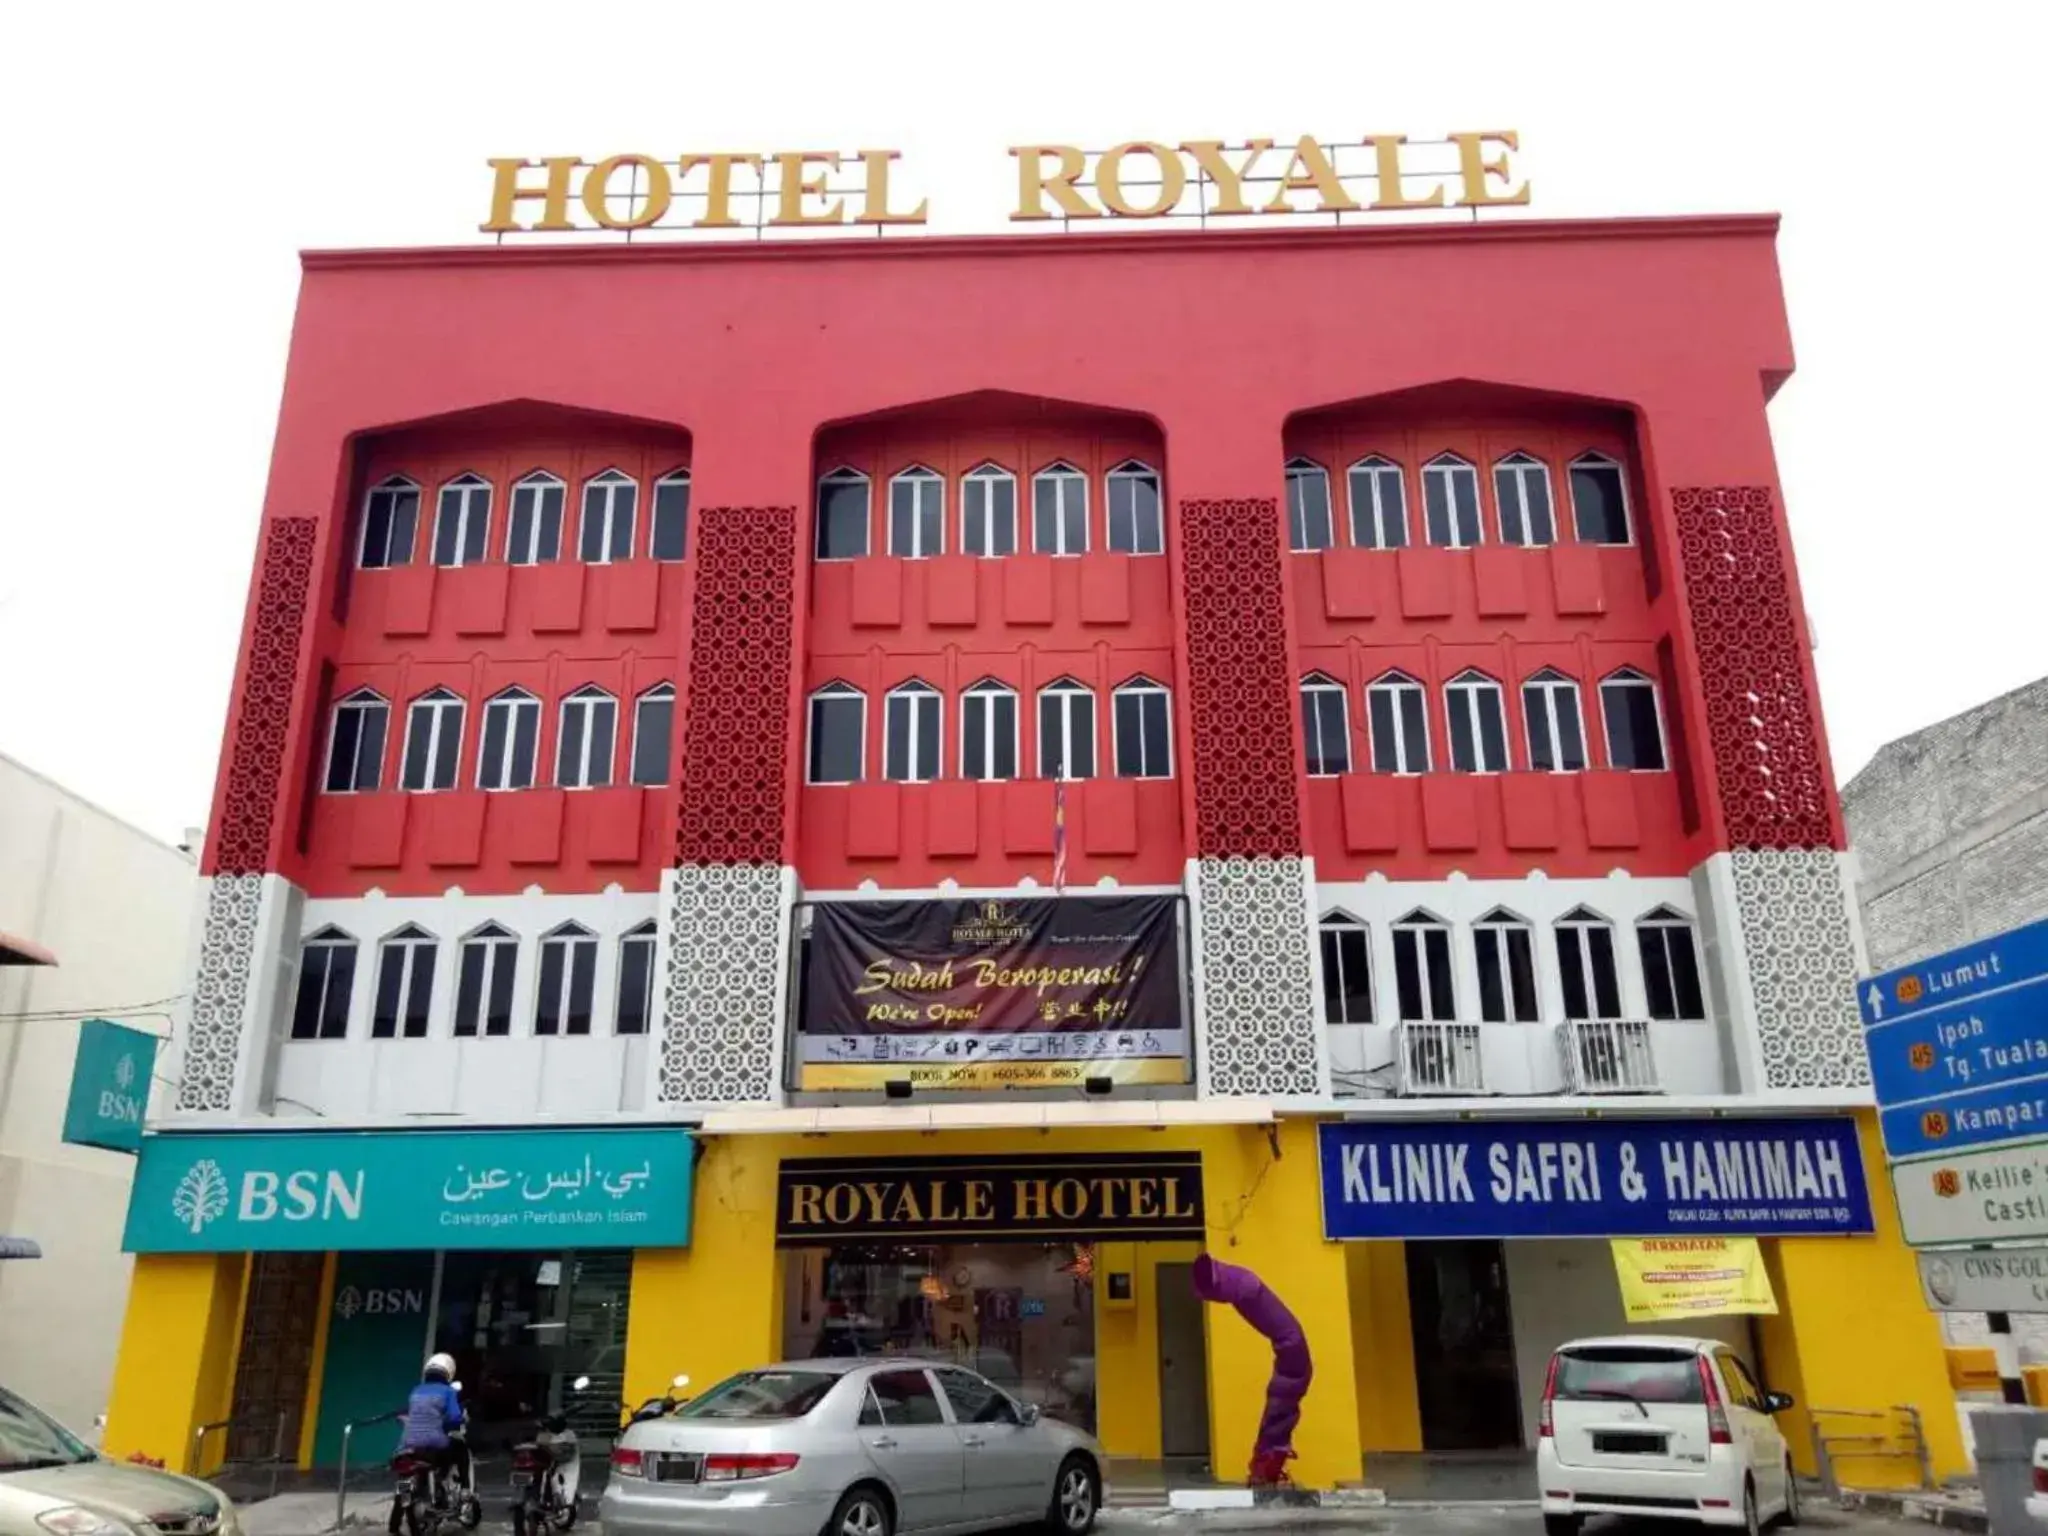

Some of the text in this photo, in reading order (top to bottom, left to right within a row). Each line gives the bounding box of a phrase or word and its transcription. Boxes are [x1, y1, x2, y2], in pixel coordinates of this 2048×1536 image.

[479, 129, 1531, 232] HOTEL ROYALE
[853, 957, 953, 994] Sudah
[1926, 951, 2001, 993] Lumut
[926, 1003, 984, 1026] Open!
[1937, 1015, 1984, 1049] Ipoh
[950, 1069, 978, 1081] NOW
[1944, 1056, 1978, 1082] Tg.
[97, 1089, 143, 1124] BSN
[1953, 1099, 2045, 1130] Kampar
[1341, 1139, 1848, 1203] KLINIK SAFRI & HAMIMAH
[237, 1169, 367, 1222] BSN
[788, 1176, 1195, 1225] ROYALE HOTEL
[439, 1209, 648, 1228] Cawangan Perbankan Islam
[1963, 1255, 2004, 1279] CWS
[364, 1287, 424, 1314] BSN
